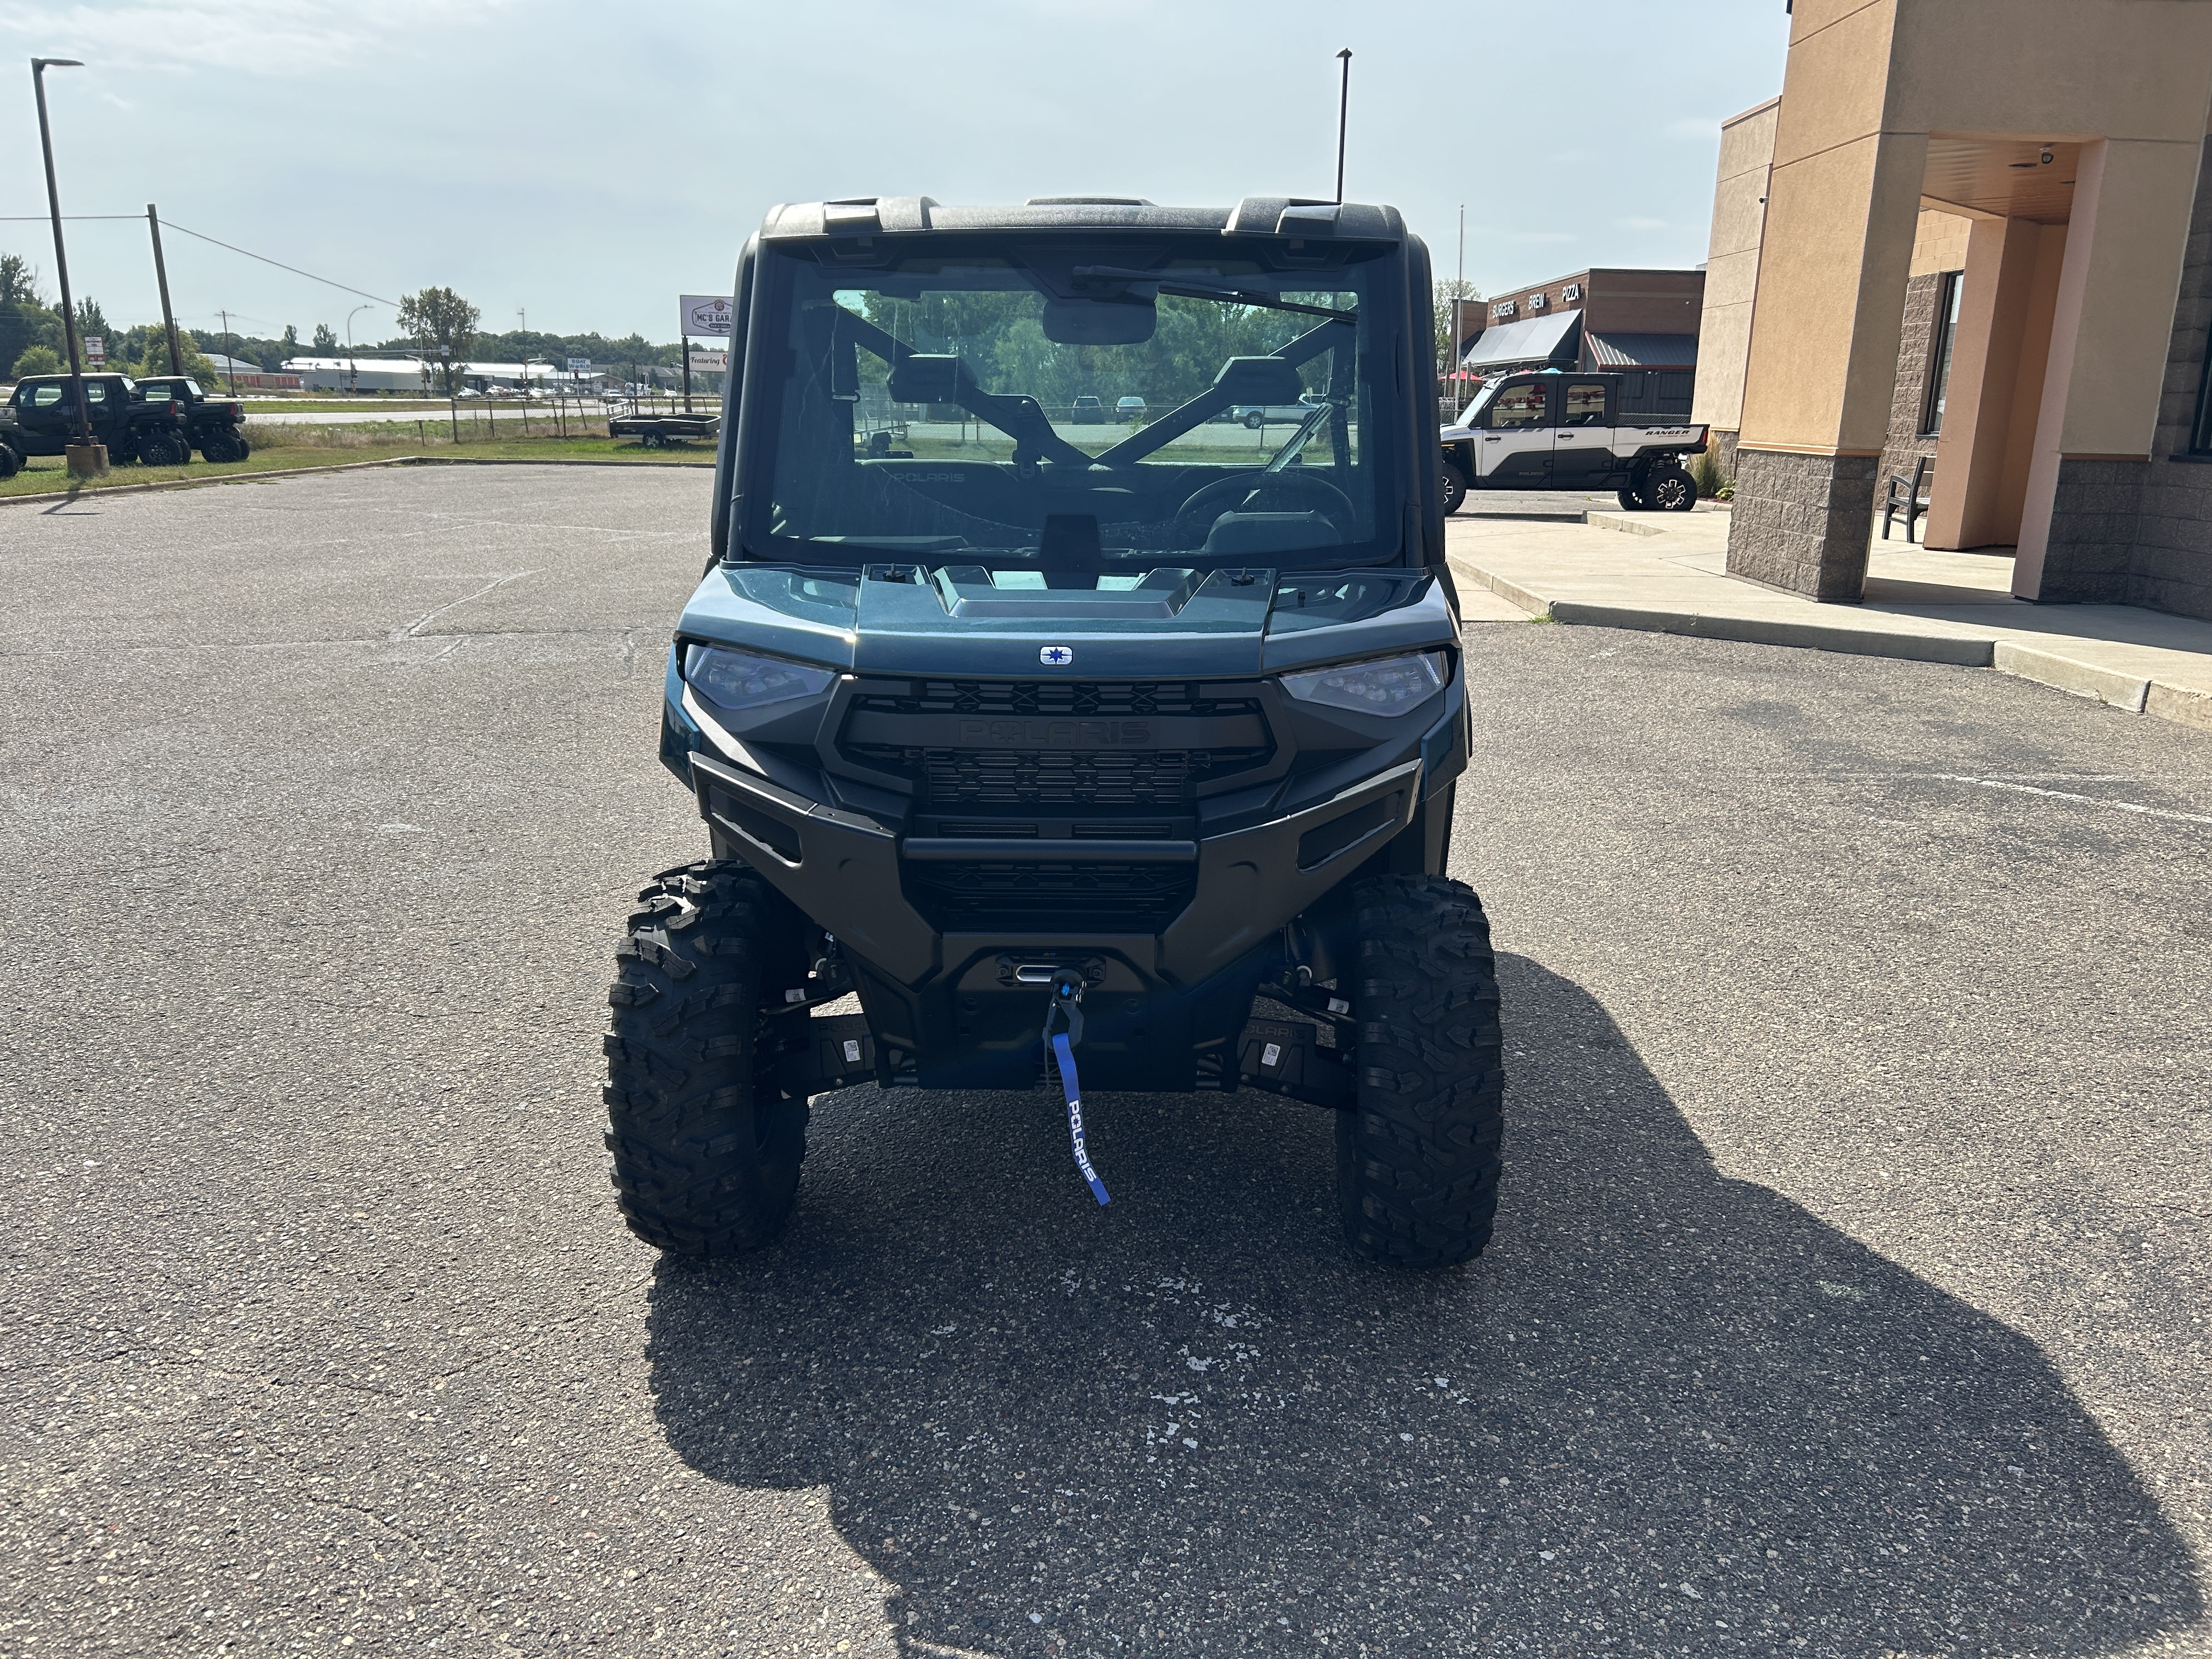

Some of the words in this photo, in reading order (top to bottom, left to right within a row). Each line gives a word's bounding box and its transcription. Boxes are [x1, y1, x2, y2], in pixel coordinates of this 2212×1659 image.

[1492, 301, 1515, 319] BURGERS
[1528, 292, 1545, 310] BREW
[1562, 284, 1579, 302] PIZZA
[690, 357, 720, 366] Featuring
[894, 473, 964, 482] POLARIS
[959, 719, 1151, 744] POLARIS
[1243, 1023, 1306, 1040] OLARIS
[1069, 1099, 1097, 1183] POLARIS
